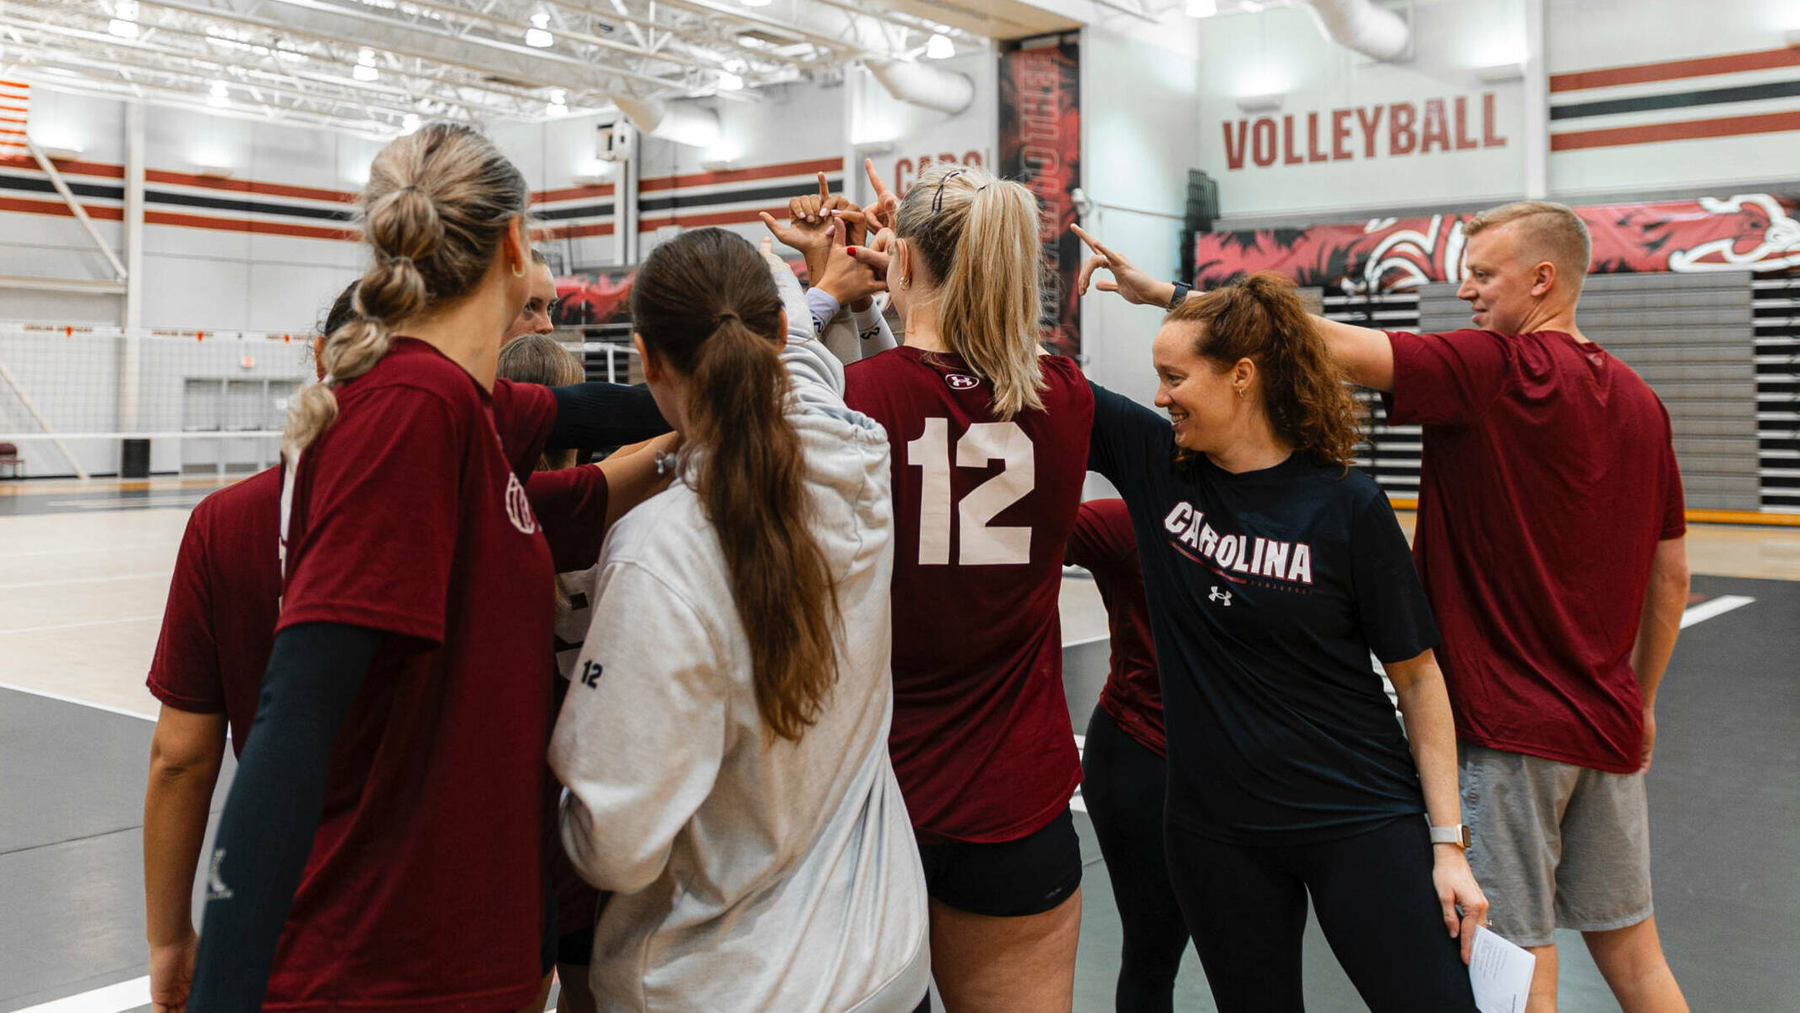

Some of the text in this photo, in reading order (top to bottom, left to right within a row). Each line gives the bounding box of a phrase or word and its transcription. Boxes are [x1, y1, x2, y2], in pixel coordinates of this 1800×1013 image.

[1222, 93, 1507, 170] VOLLEYBALL
[907, 417, 1035, 565] 12
[1164, 501, 1313, 584] CAROLINA
[581, 659, 603, 689] 12
